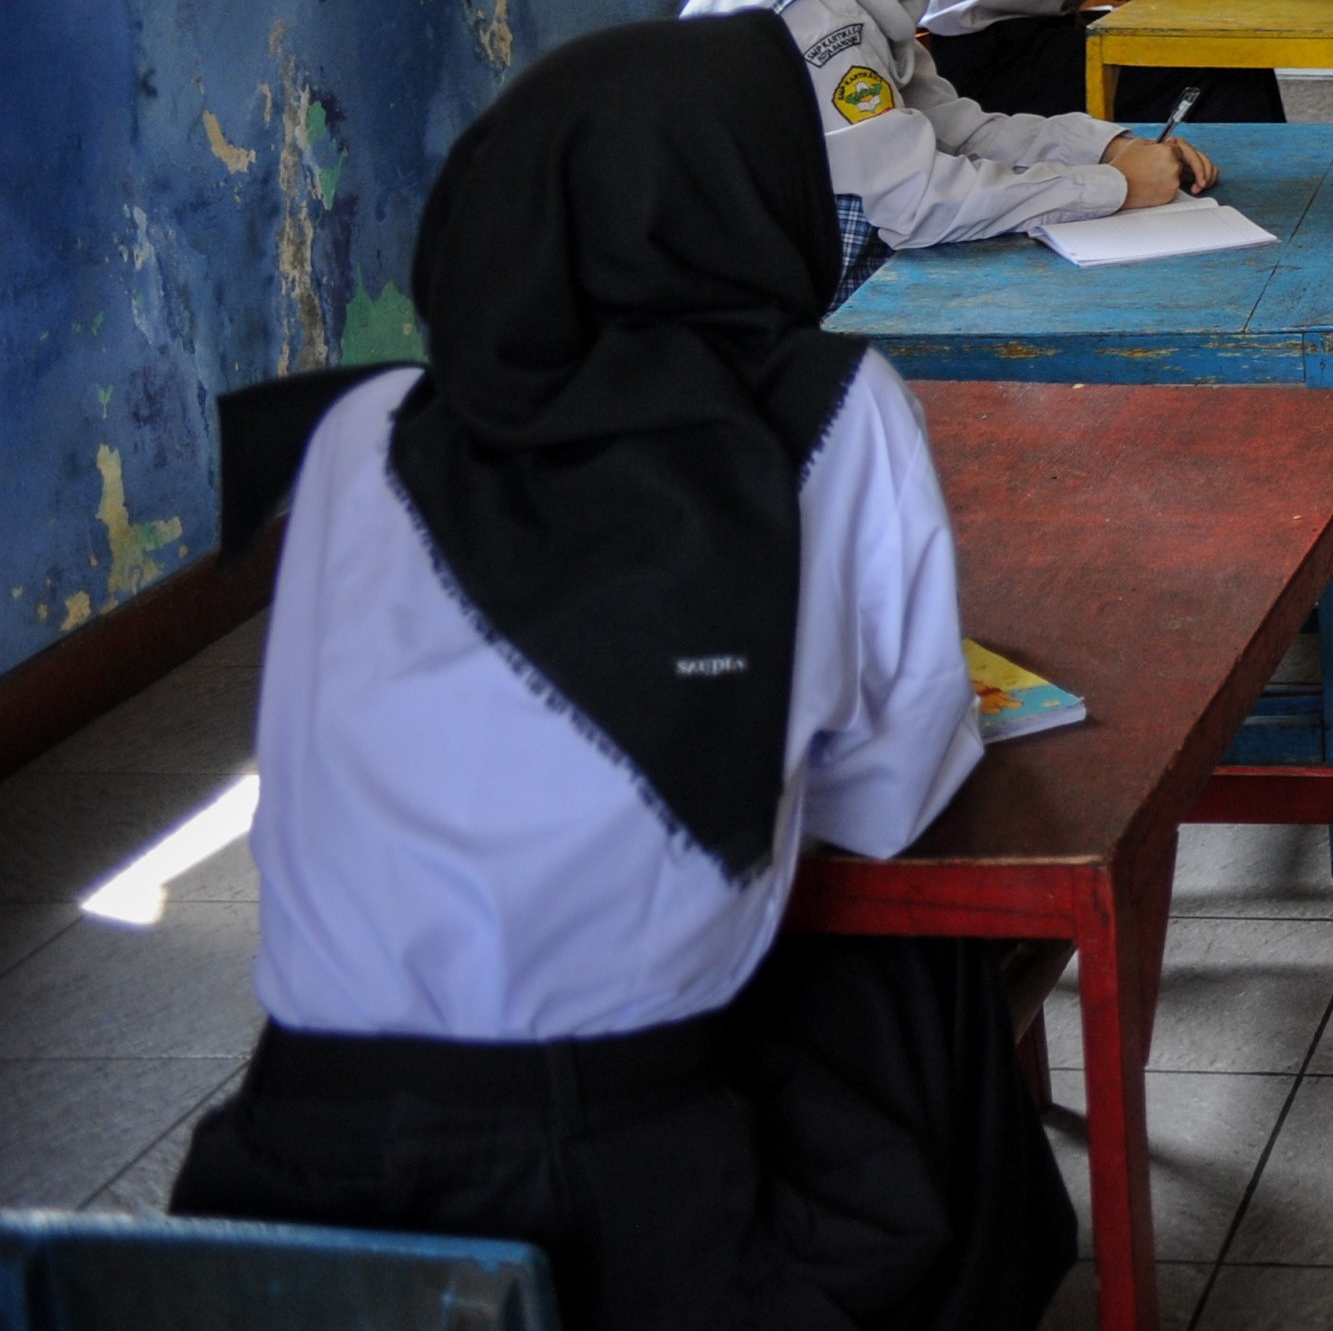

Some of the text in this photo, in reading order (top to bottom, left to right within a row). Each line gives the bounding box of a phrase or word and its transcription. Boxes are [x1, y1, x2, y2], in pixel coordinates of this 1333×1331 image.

[807, 45, 822, 60] SMP
[822, 30, 851, 48] KARTIKA
[818, 49, 832, 61] KOTA
